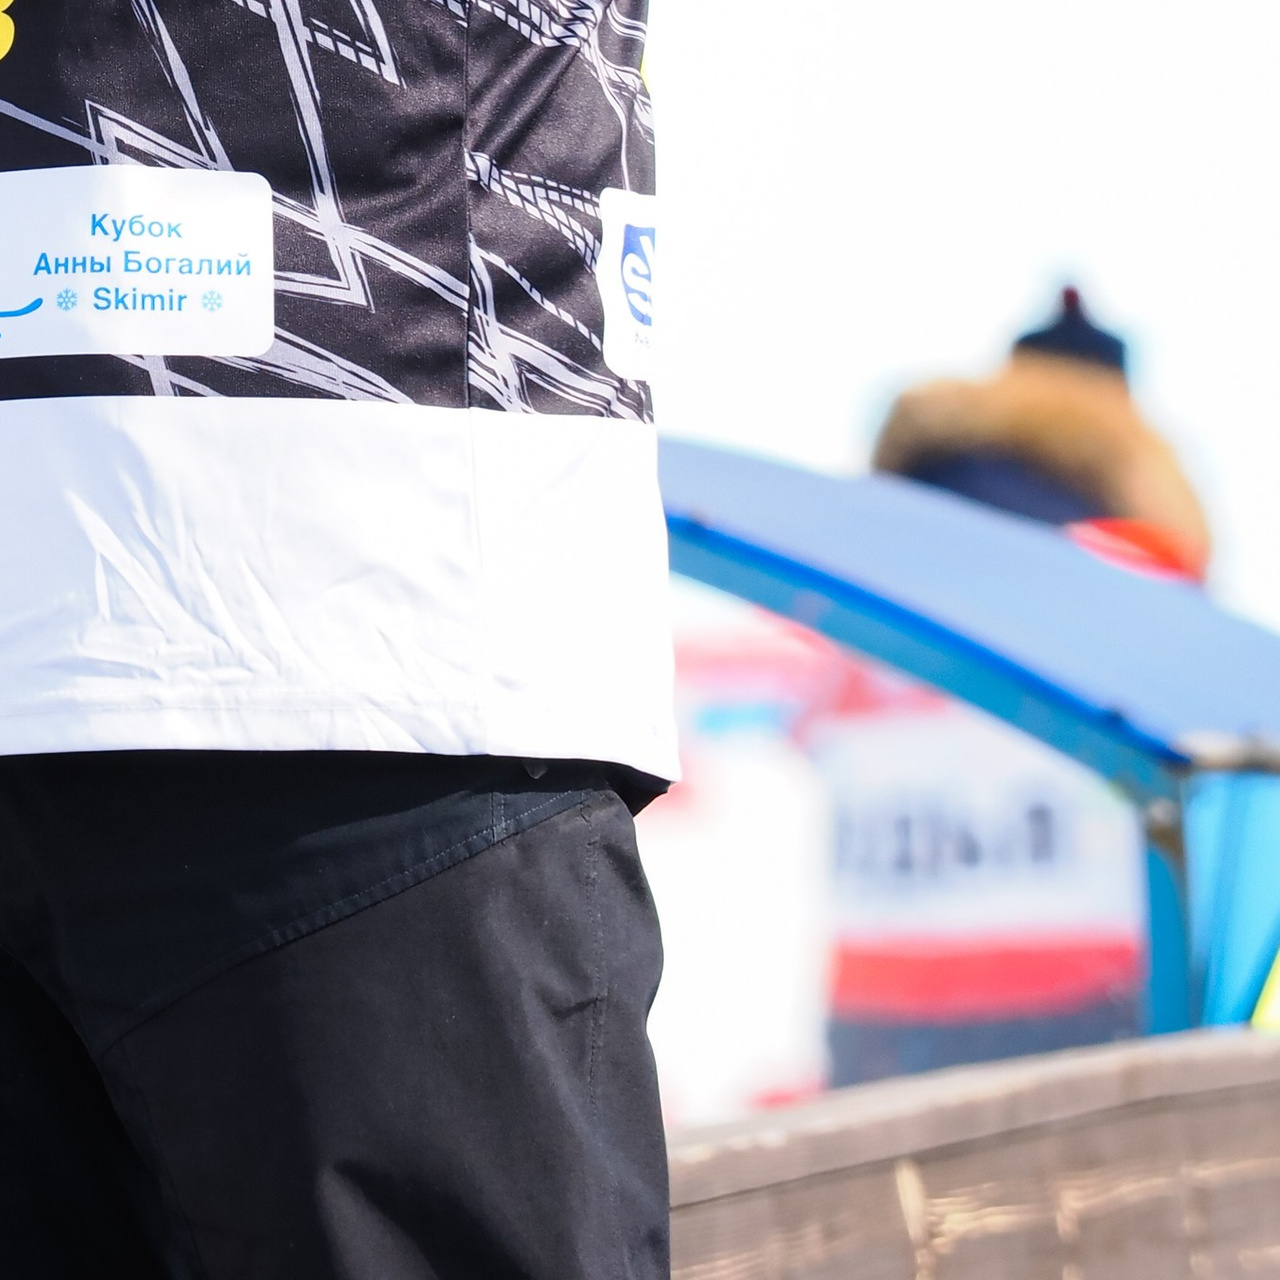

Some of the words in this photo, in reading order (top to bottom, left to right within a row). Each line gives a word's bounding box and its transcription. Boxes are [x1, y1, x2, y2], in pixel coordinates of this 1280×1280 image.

[90, 213, 183, 242] Кубок
[33, 252, 111, 276] Анны
[123, 250, 252, 276] Богалий
[93, 286, 188, 312] Skimir
